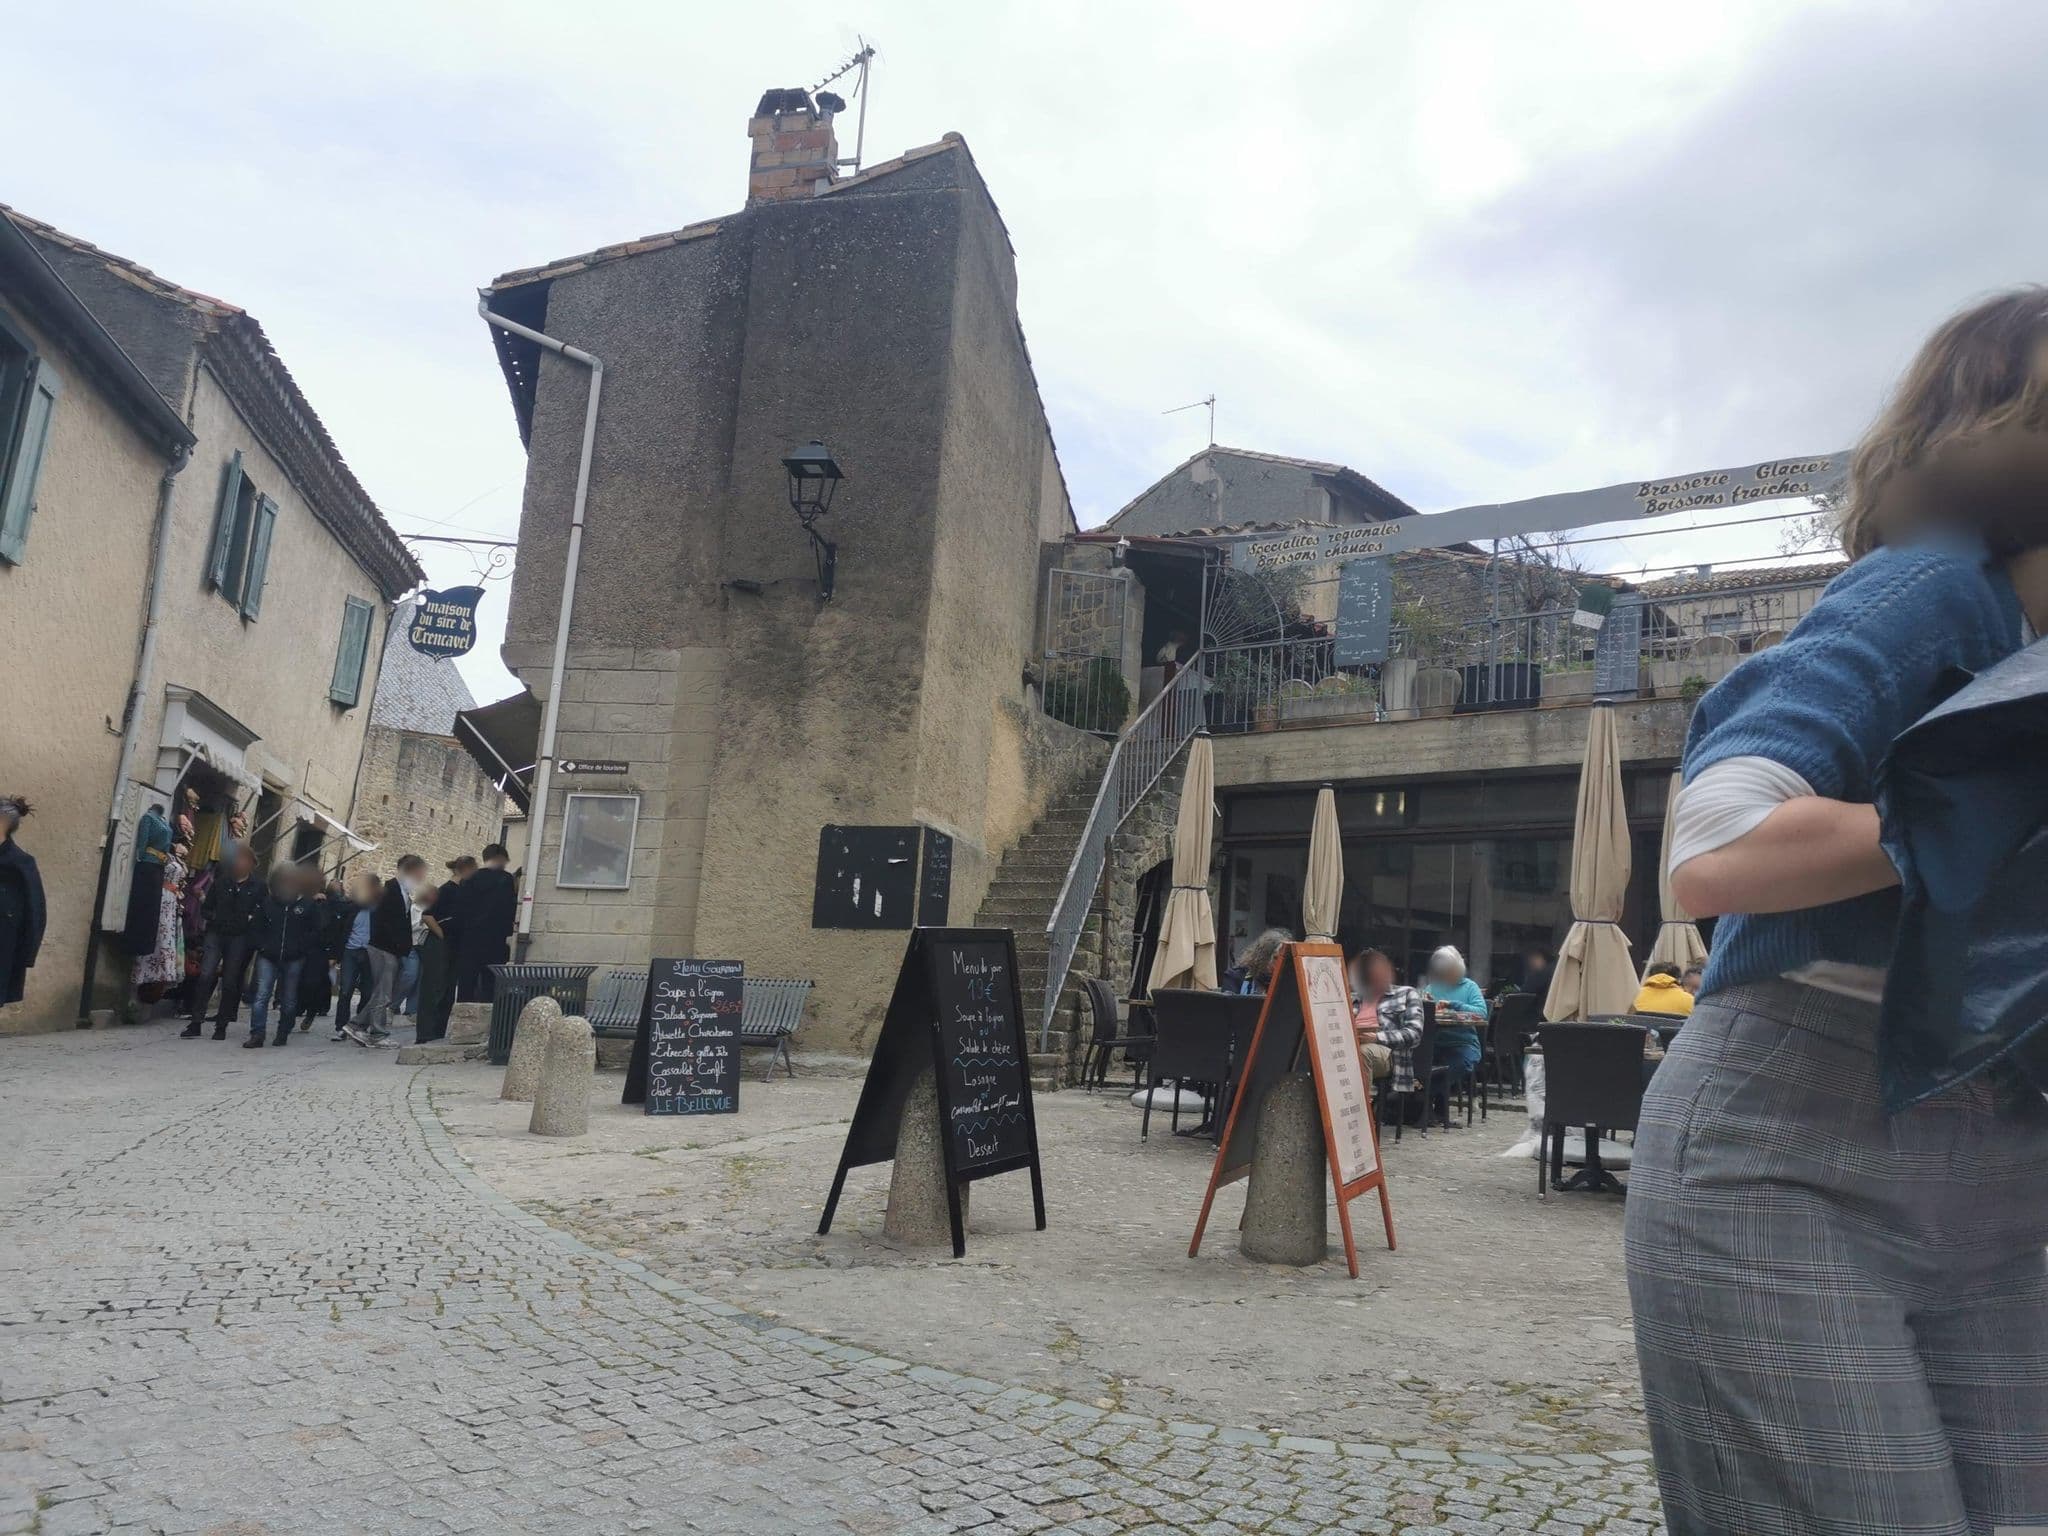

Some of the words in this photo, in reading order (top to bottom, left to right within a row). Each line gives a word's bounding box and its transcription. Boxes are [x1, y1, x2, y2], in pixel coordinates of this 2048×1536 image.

[1636, 473, 1729, 498] Brasserie
[1755, 460, 1831, 480] Glacier
[1641, 491, 1724, 514] Boissons
[1257, 550, 1317, 568] Boissons
[1325, 540, 1383, 558] chaudes
[426, 601, 471, 617] maison
[419, 611, 433, 626] du
[436, 615, 456, 629] sire
[460, 618, 472, 631] de
[412, 626, 471, 649] Trencavel
[953, 950, 979, 975] Menu
[651, 1003, 686, 1020] Salade
[968, 1134, 999, 1158] Dessert
